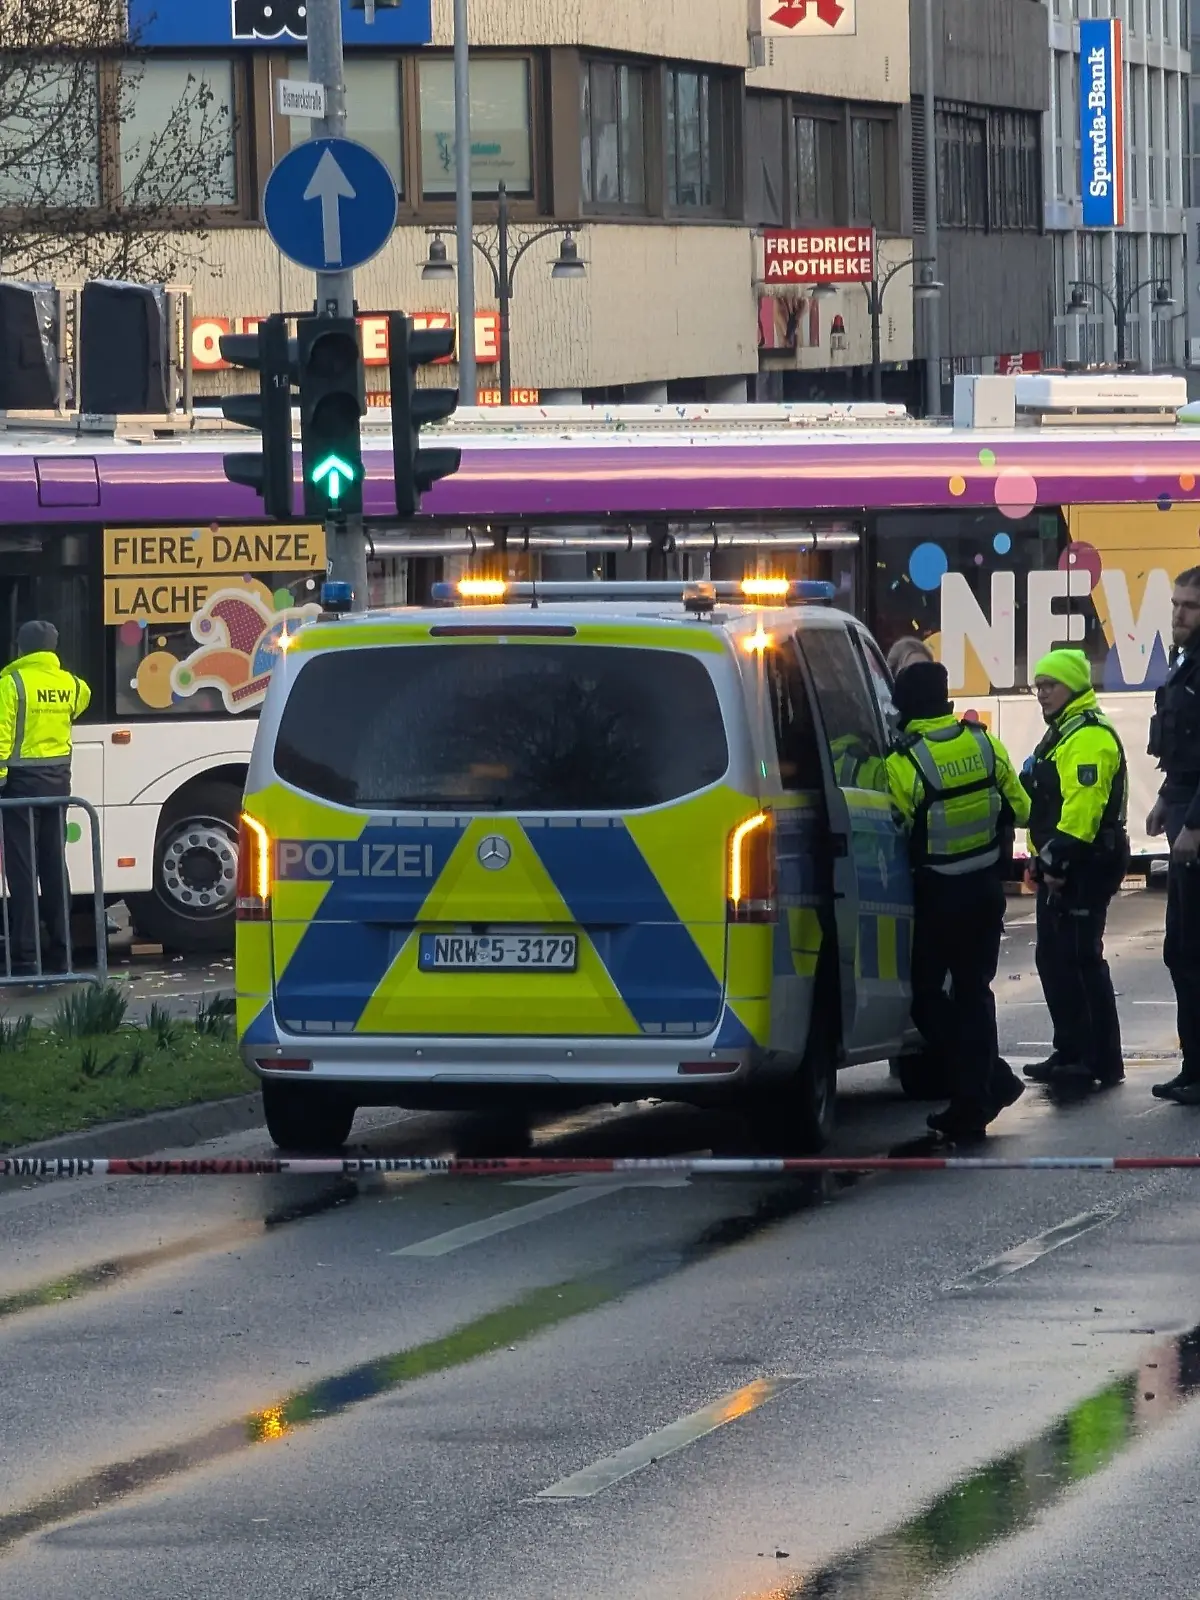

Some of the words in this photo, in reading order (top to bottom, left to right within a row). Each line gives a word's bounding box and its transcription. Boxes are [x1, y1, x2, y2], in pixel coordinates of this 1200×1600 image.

[1088, 47, 1112, 197] Sparda-Bank
[766, 236, 871, 254] FRIEDRICH
[768, 258, 871, 276] APOTHEKE
[114, 536, 203, 569] FIERE,
[212, 533, 317, 566] DANZE,
[941, 568, 1176, 690] NEW
[37, 689, 71, 703] NEW
[938, 753, 985, 780] POLIZEI
[279, 843, 433, 877] POLIZEI
[435, 938, 477, 963] NRW
[491, 939, 574, 963] 5-3179
